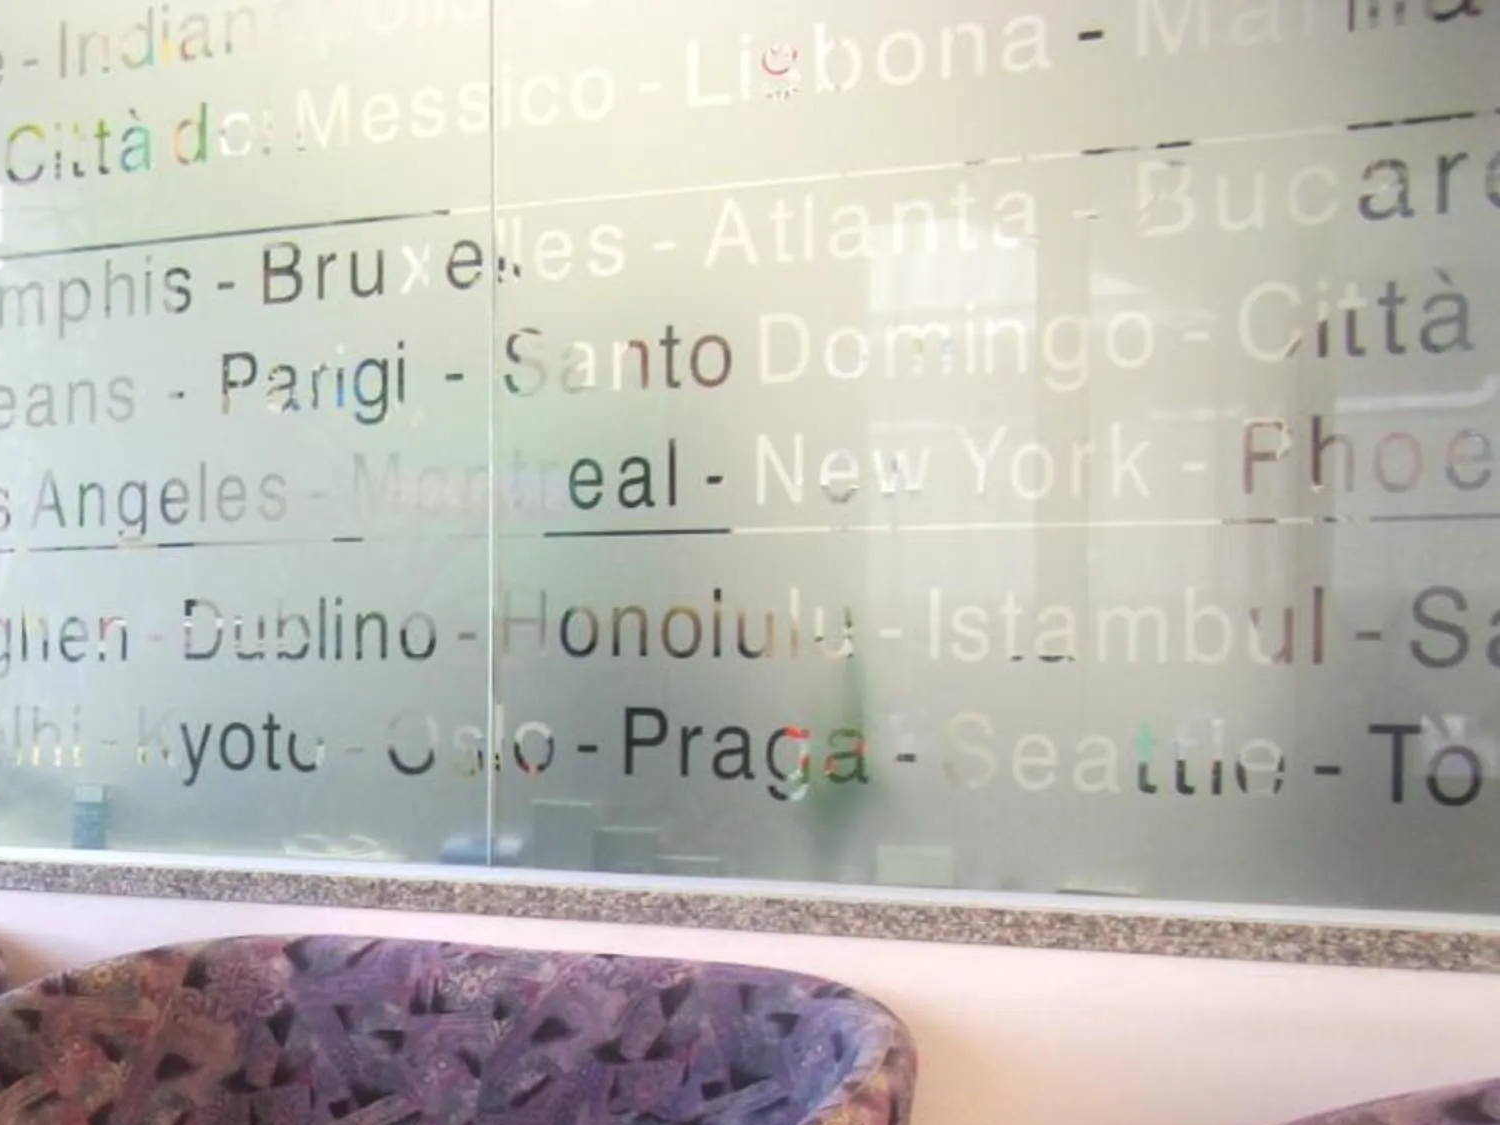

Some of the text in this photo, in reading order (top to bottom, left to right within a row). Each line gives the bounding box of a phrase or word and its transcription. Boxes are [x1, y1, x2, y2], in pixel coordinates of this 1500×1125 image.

[5, 107, 152, 184] Città
[297, 62, 617, 152] Messico
[261, 217, 627, 305] Bruxelles
[703, 181, 1040, 270] Atlanta
[1137, 148, 1500, 238] Bucar
[220, 341, 406, 424] Parigi
[504, 323, 733, 397] Santo
[757, 301, 1155, 393] Domingo
[1237, 266, 1475, 362] Città
[31, 460, 288, 545] Angeles
[756, 432, 932, 505] New
[956, 421, 1153, 499] York
[183, 596, 437, 661] Dublino
[927, 583, 1325, 666] Istambul
[623, 706, 870, 802] Praga
